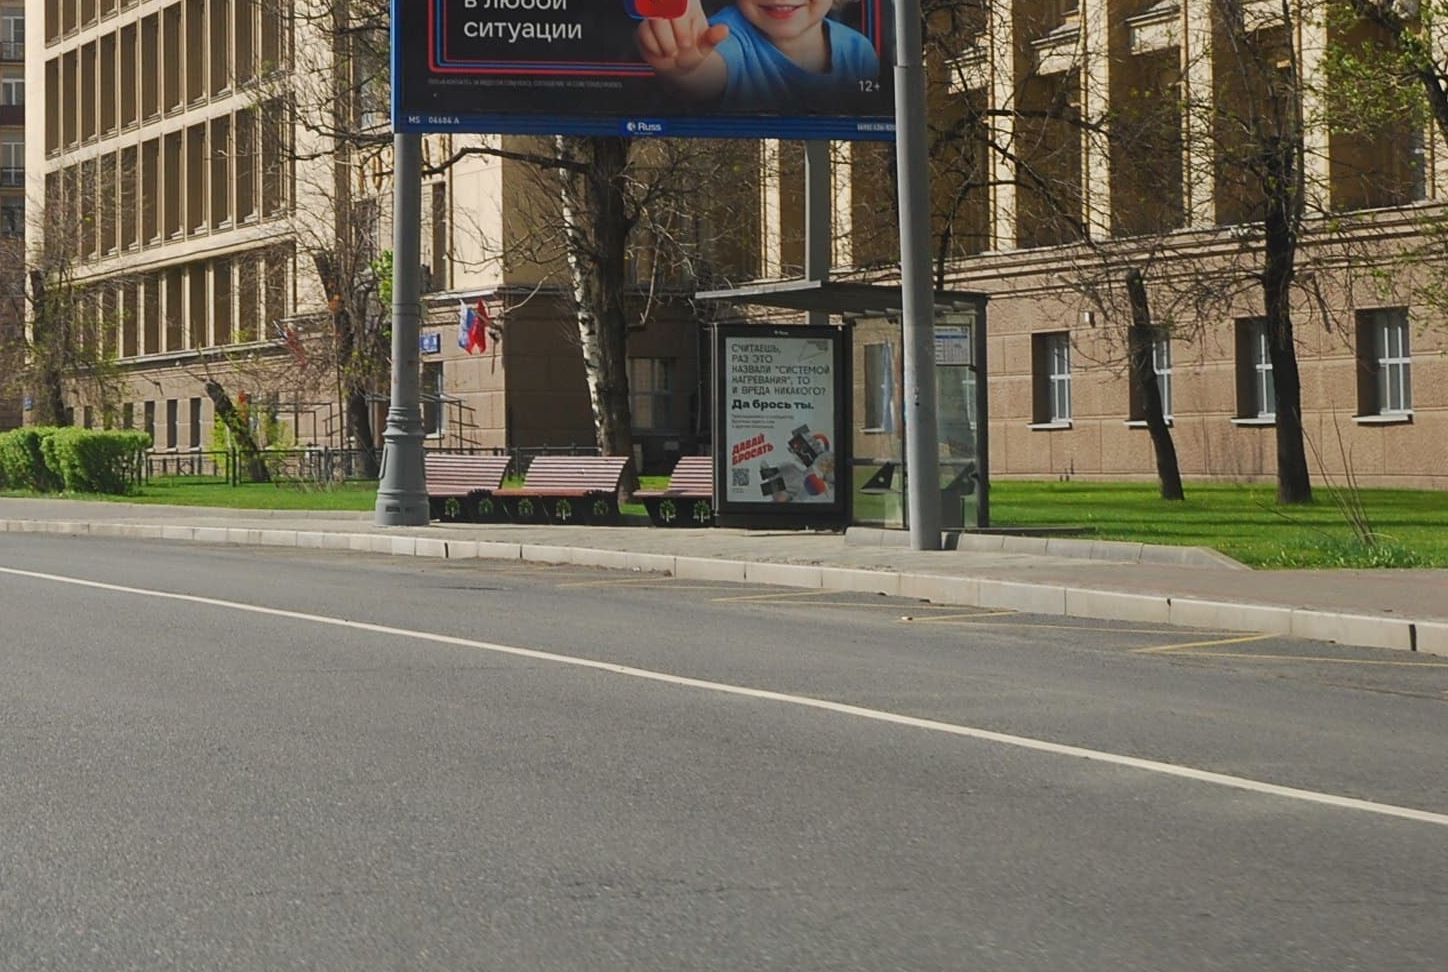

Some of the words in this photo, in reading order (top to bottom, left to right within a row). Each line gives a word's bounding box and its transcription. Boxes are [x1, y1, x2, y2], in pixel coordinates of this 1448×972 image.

[463, 21, 582, 43] ситуации
[855, 79, 881, 93] 12+
[637, 121, 662, 131] Russ
[731, 399, 751, 410] Да
[752, 399, 792, 411] брось
